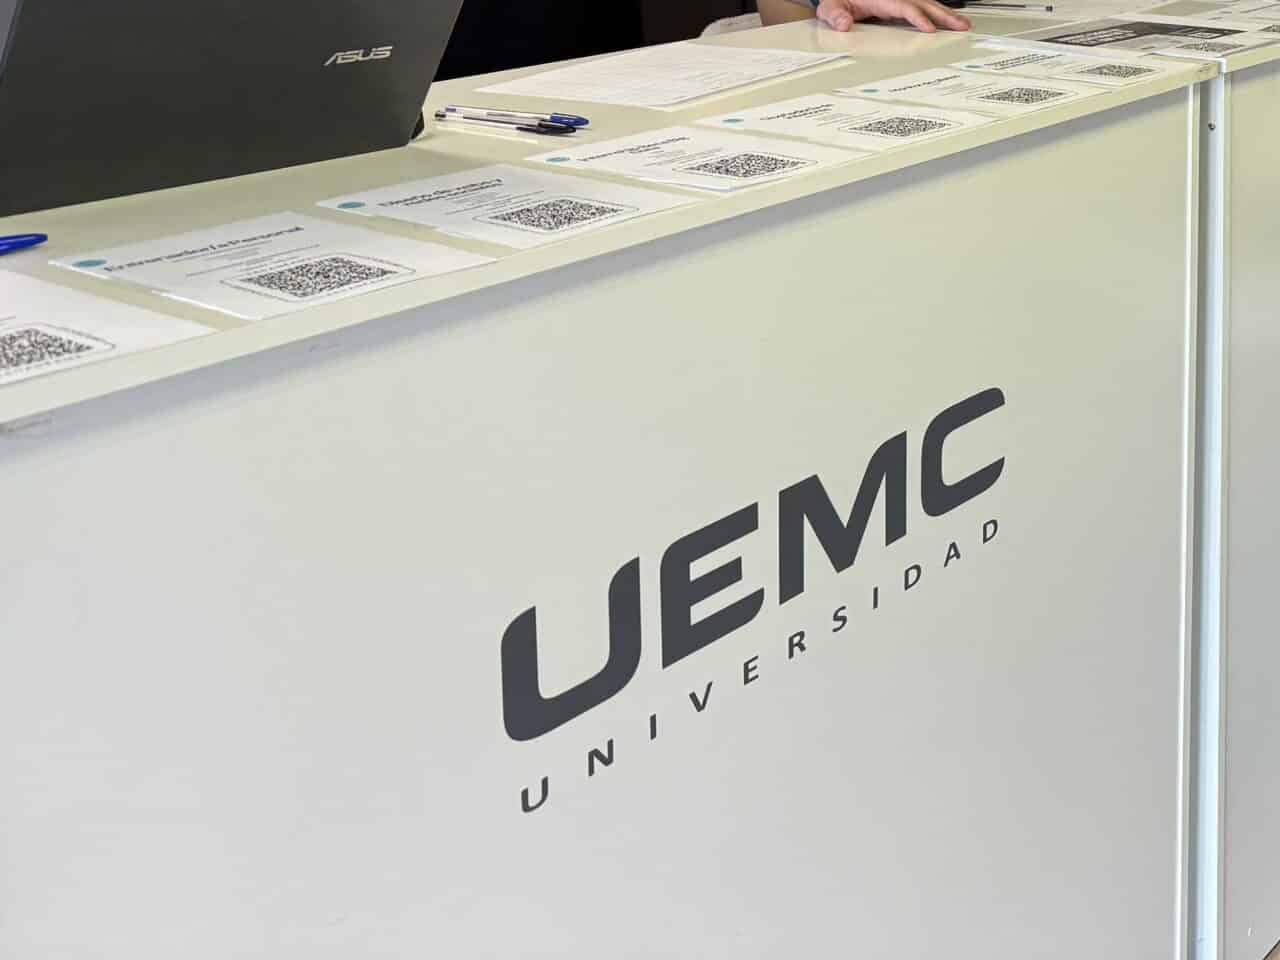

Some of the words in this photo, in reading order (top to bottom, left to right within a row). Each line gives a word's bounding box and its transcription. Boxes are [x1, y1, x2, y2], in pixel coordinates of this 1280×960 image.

[323, 45, 393, 66] ASUS
[501, 387, 1005, 742] UEMC
[521, 518, 998, 814] UNIVERSIDAD
